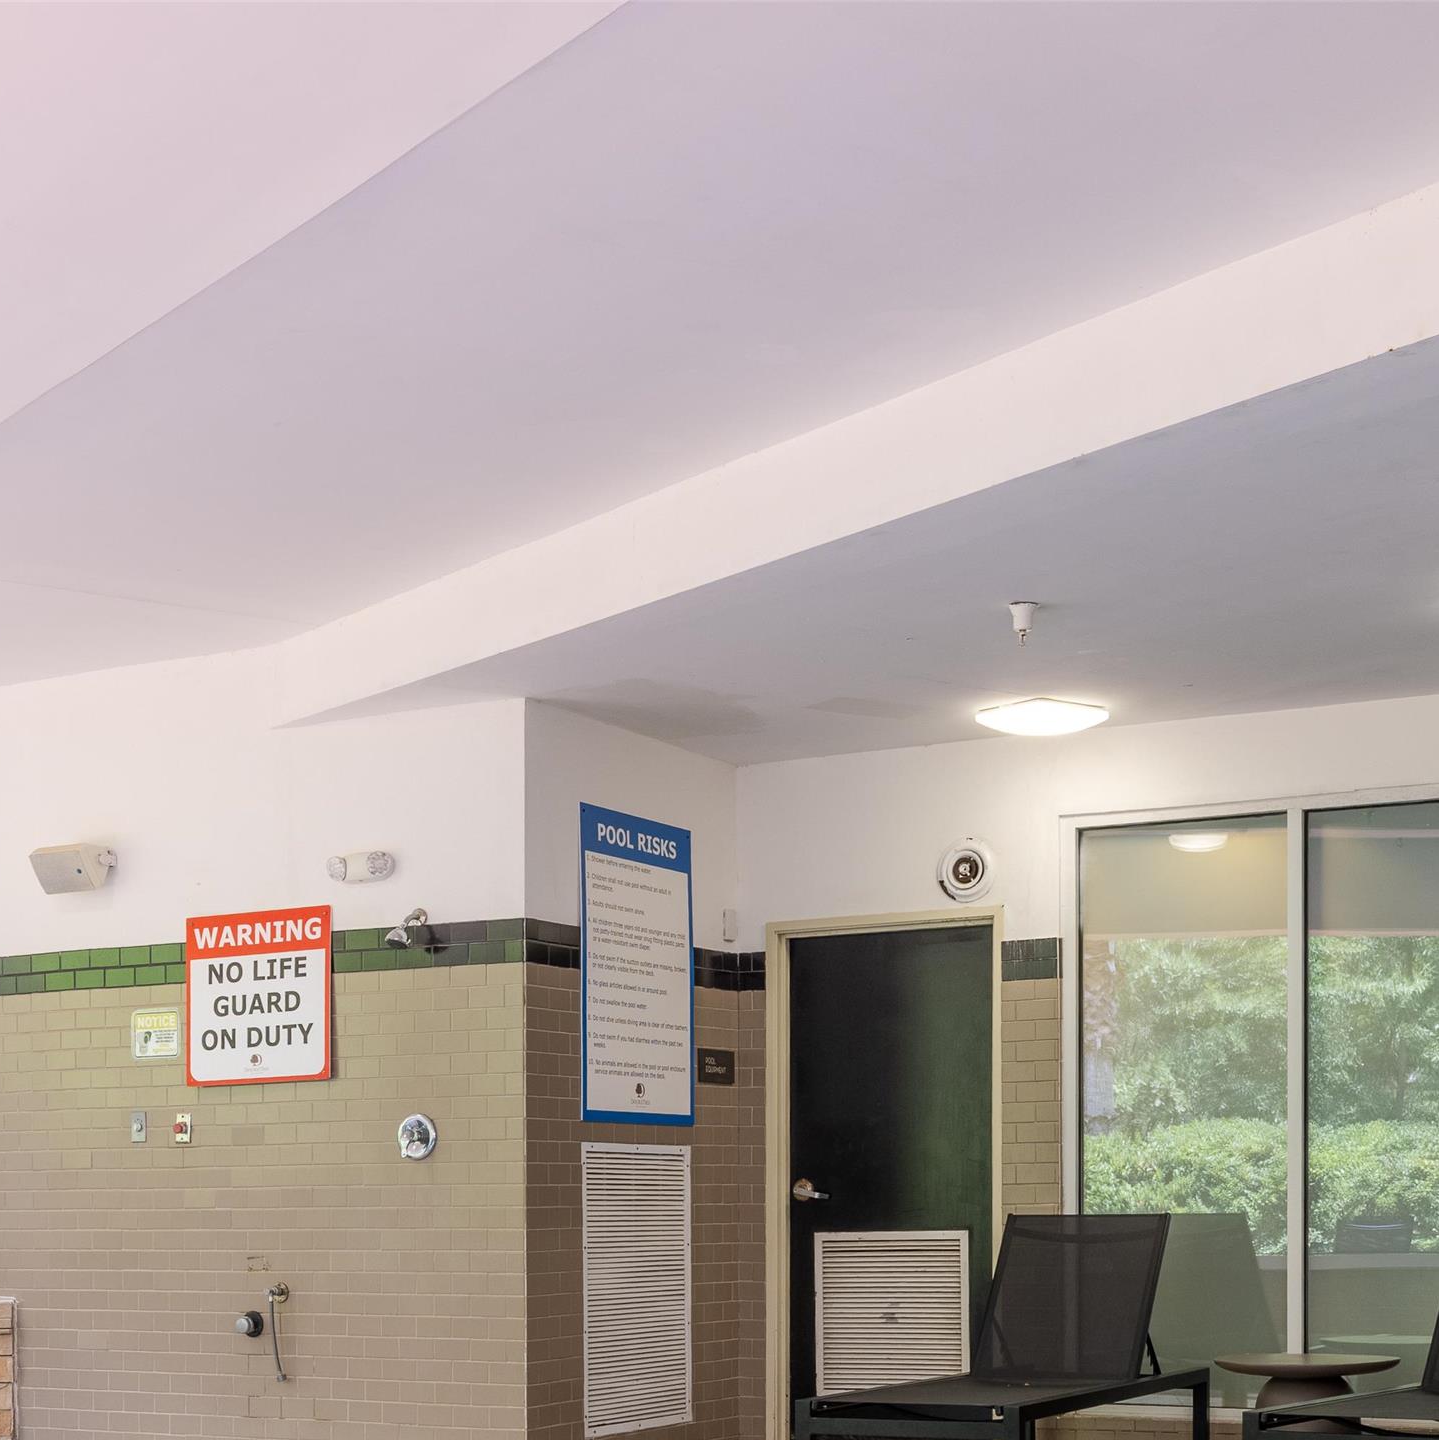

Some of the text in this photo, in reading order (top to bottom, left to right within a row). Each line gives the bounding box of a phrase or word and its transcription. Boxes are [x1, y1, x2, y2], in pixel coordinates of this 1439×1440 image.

[597, 823, 677, 860] POOL RISKS
[194, 918, 322, 949] WARNING
[208, 957, 307, 984] NO LIFE
[214, 991, 301, 1017] GUARD
[137, 1015, 176, 1029] NOTICE
[202, 1028, 236, 1051] ON
[247, 1023, 313, 1048] DUTY
